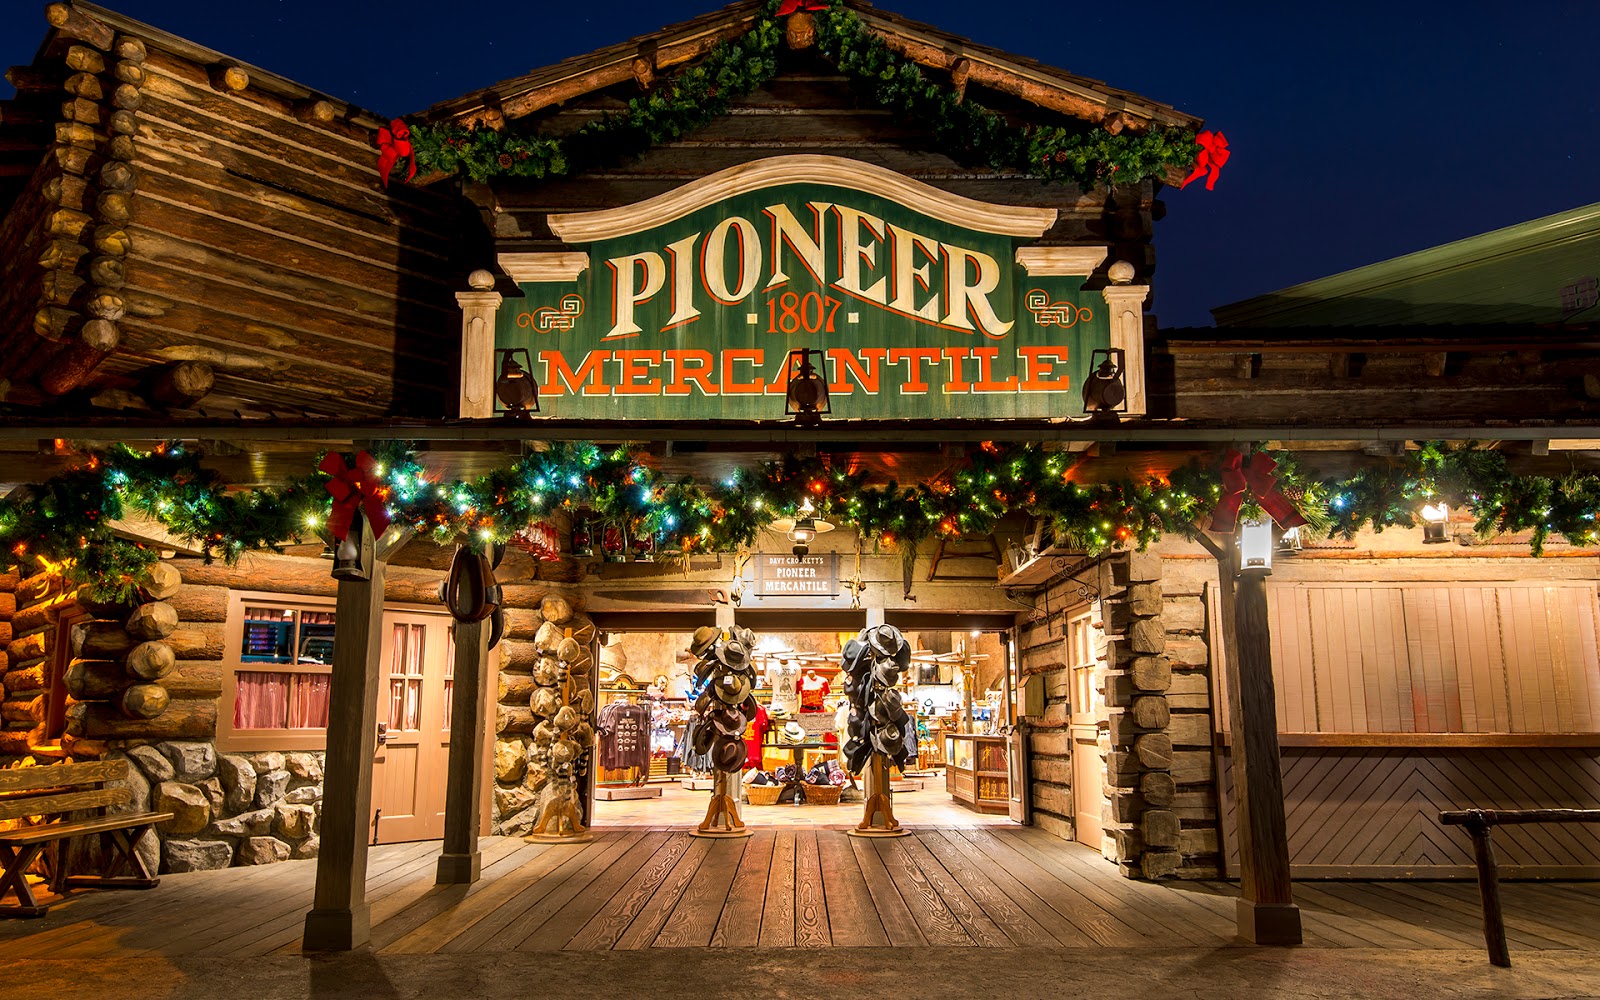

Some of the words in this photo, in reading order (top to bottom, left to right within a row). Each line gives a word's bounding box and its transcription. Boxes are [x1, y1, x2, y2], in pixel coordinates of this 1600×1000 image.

[600, 201, 1015, 341] PIONEER
[766, 291, 842, 333] 1807
[786, 556, 823, 565] CROKETT'S
[776, 568, 816, 578] PIONEER
[765, 581, 828, 592] MERCANTILE
